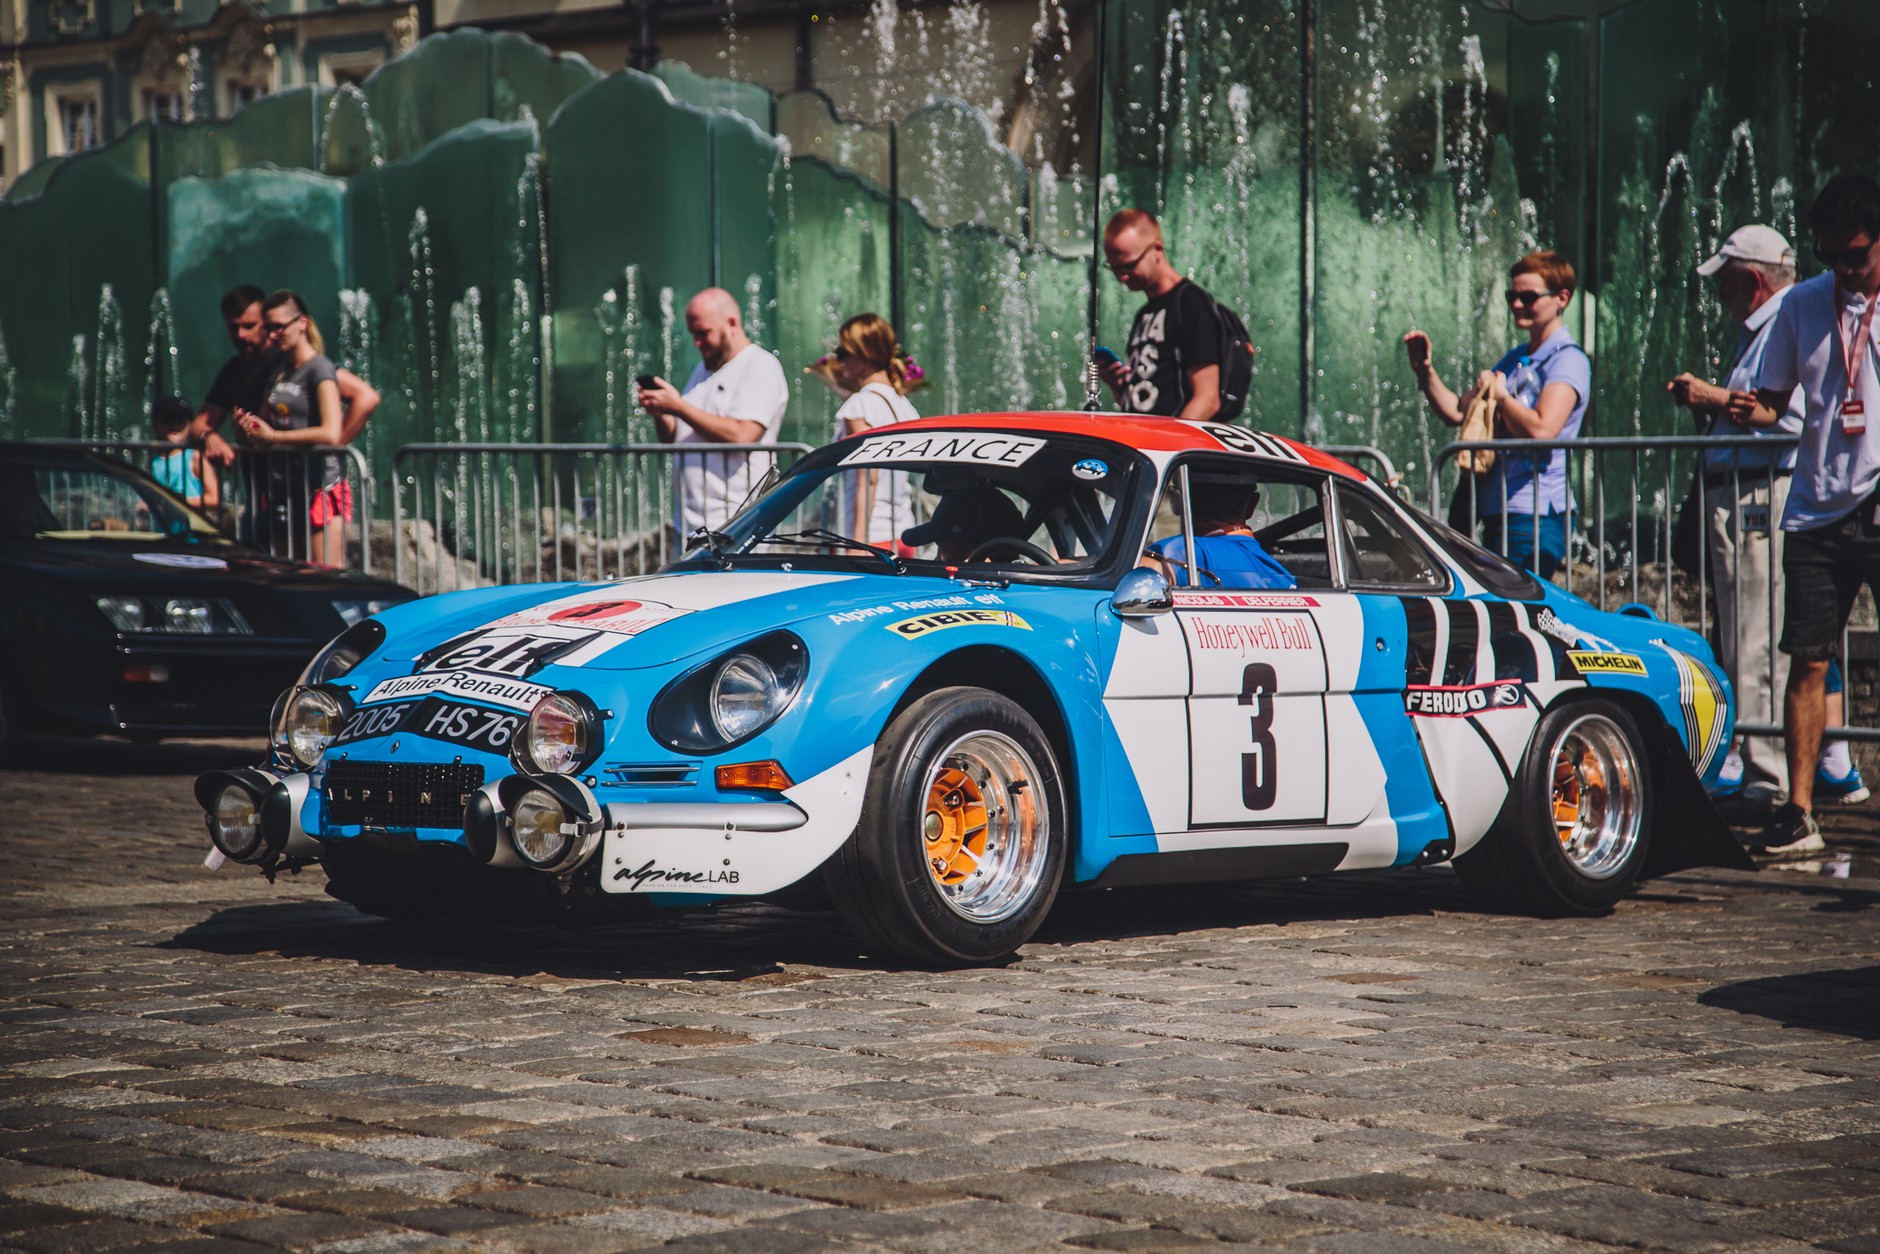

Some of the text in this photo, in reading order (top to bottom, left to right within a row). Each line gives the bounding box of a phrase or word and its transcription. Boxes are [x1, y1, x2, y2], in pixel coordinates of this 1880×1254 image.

[849, 439, 1035, 463] FRANCE
[828, 593, 1005, 626] Alpine Renault elf
[897, 611, 997, 634] CIBIE
[1191, 617, 1312, 658] Honeywell Bull
[1575, 655, 1643, 671] MICHELIN
[1406, 689, 1487, 714] FERODO
[337, 703, 410, 742] 2005
[1237, 662, 1278, 811] 3
[613, 859, 740, 891] alpine LAB
